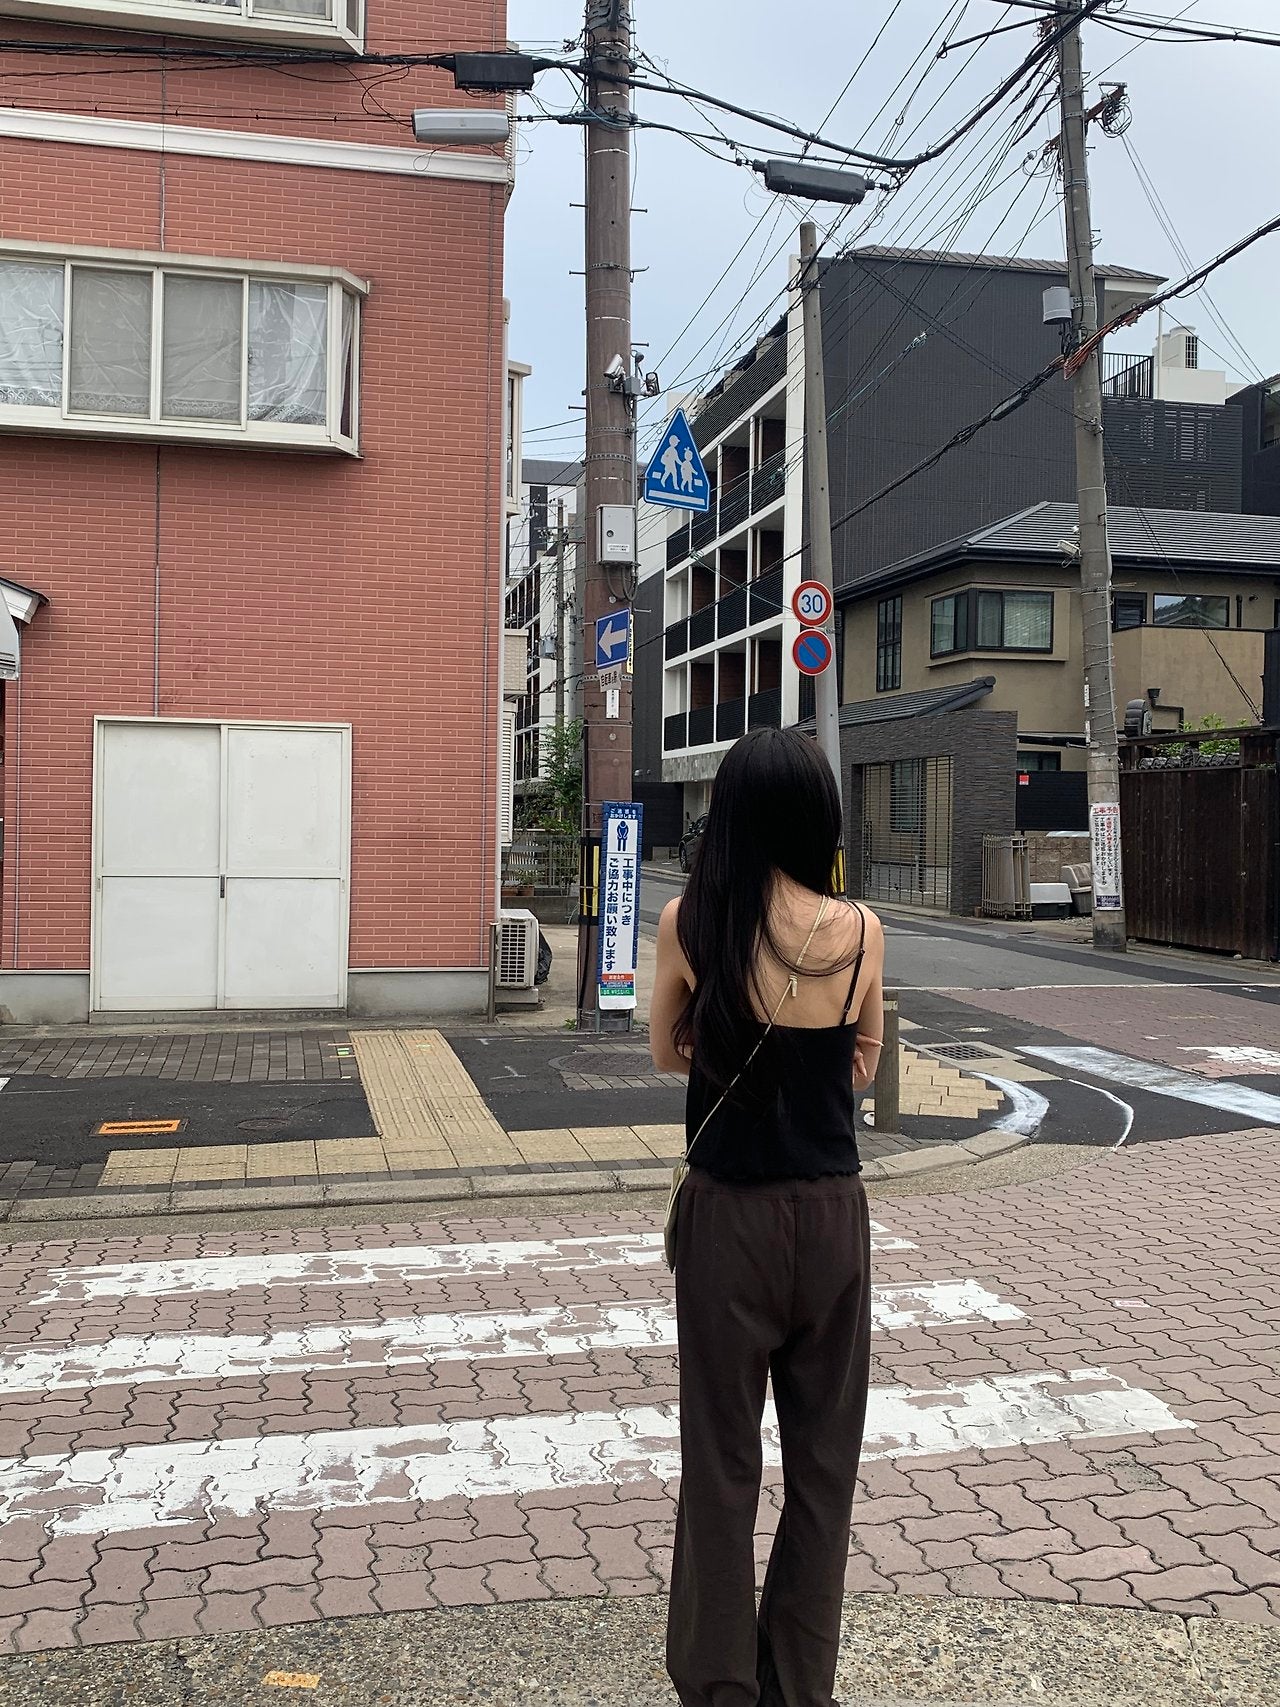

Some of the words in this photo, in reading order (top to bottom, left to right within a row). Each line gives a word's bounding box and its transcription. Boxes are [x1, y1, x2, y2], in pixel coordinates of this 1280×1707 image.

[801, 594, 823, 614] 30
[604, 857, 620, 971] ご協力お願い致します
[621, 858, 634, 926] 工事中につき
